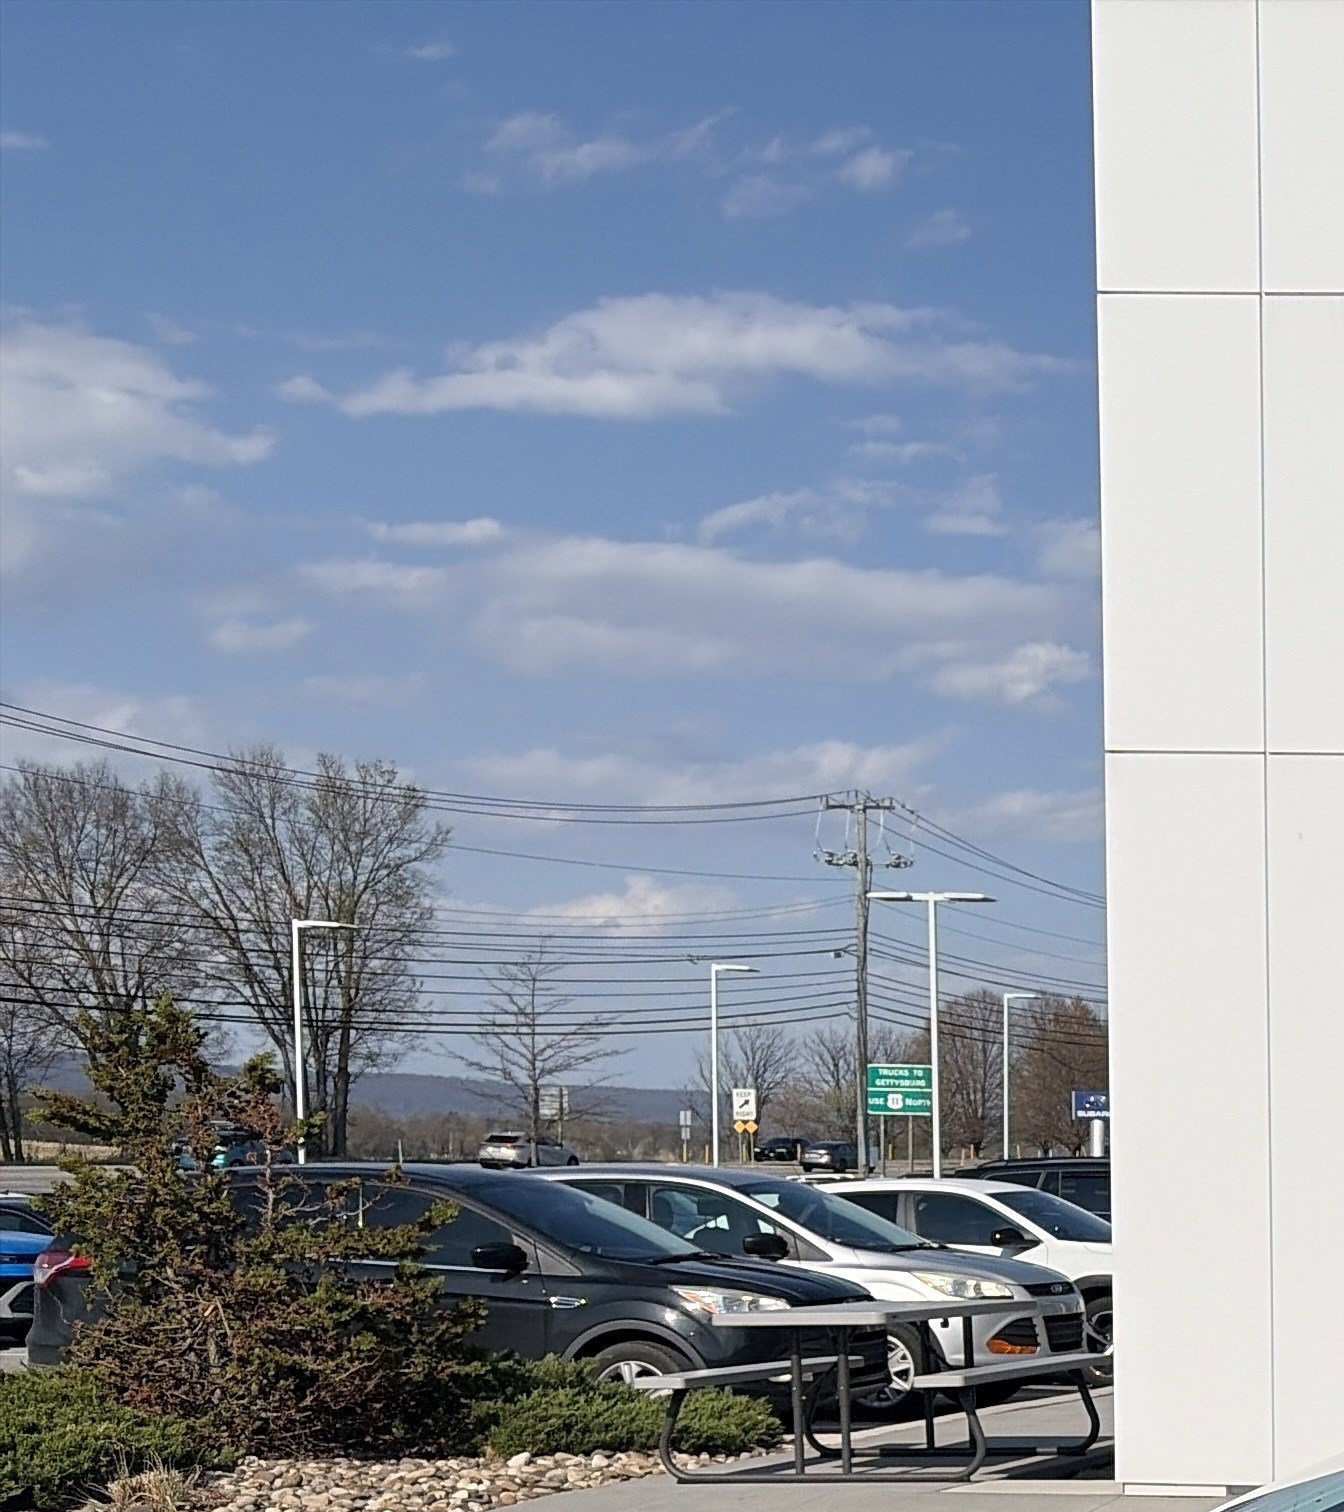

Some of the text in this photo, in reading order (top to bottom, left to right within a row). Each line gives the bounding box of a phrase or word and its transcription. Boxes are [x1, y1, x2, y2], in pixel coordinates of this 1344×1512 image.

[878, 1068, 924, 1077] TRUCKS TO
[875, 1078, 926, 1087] GETTYSBURG
[868, 1097, 885, 1105] USE
[891, 1097, 899, 1106] 11
